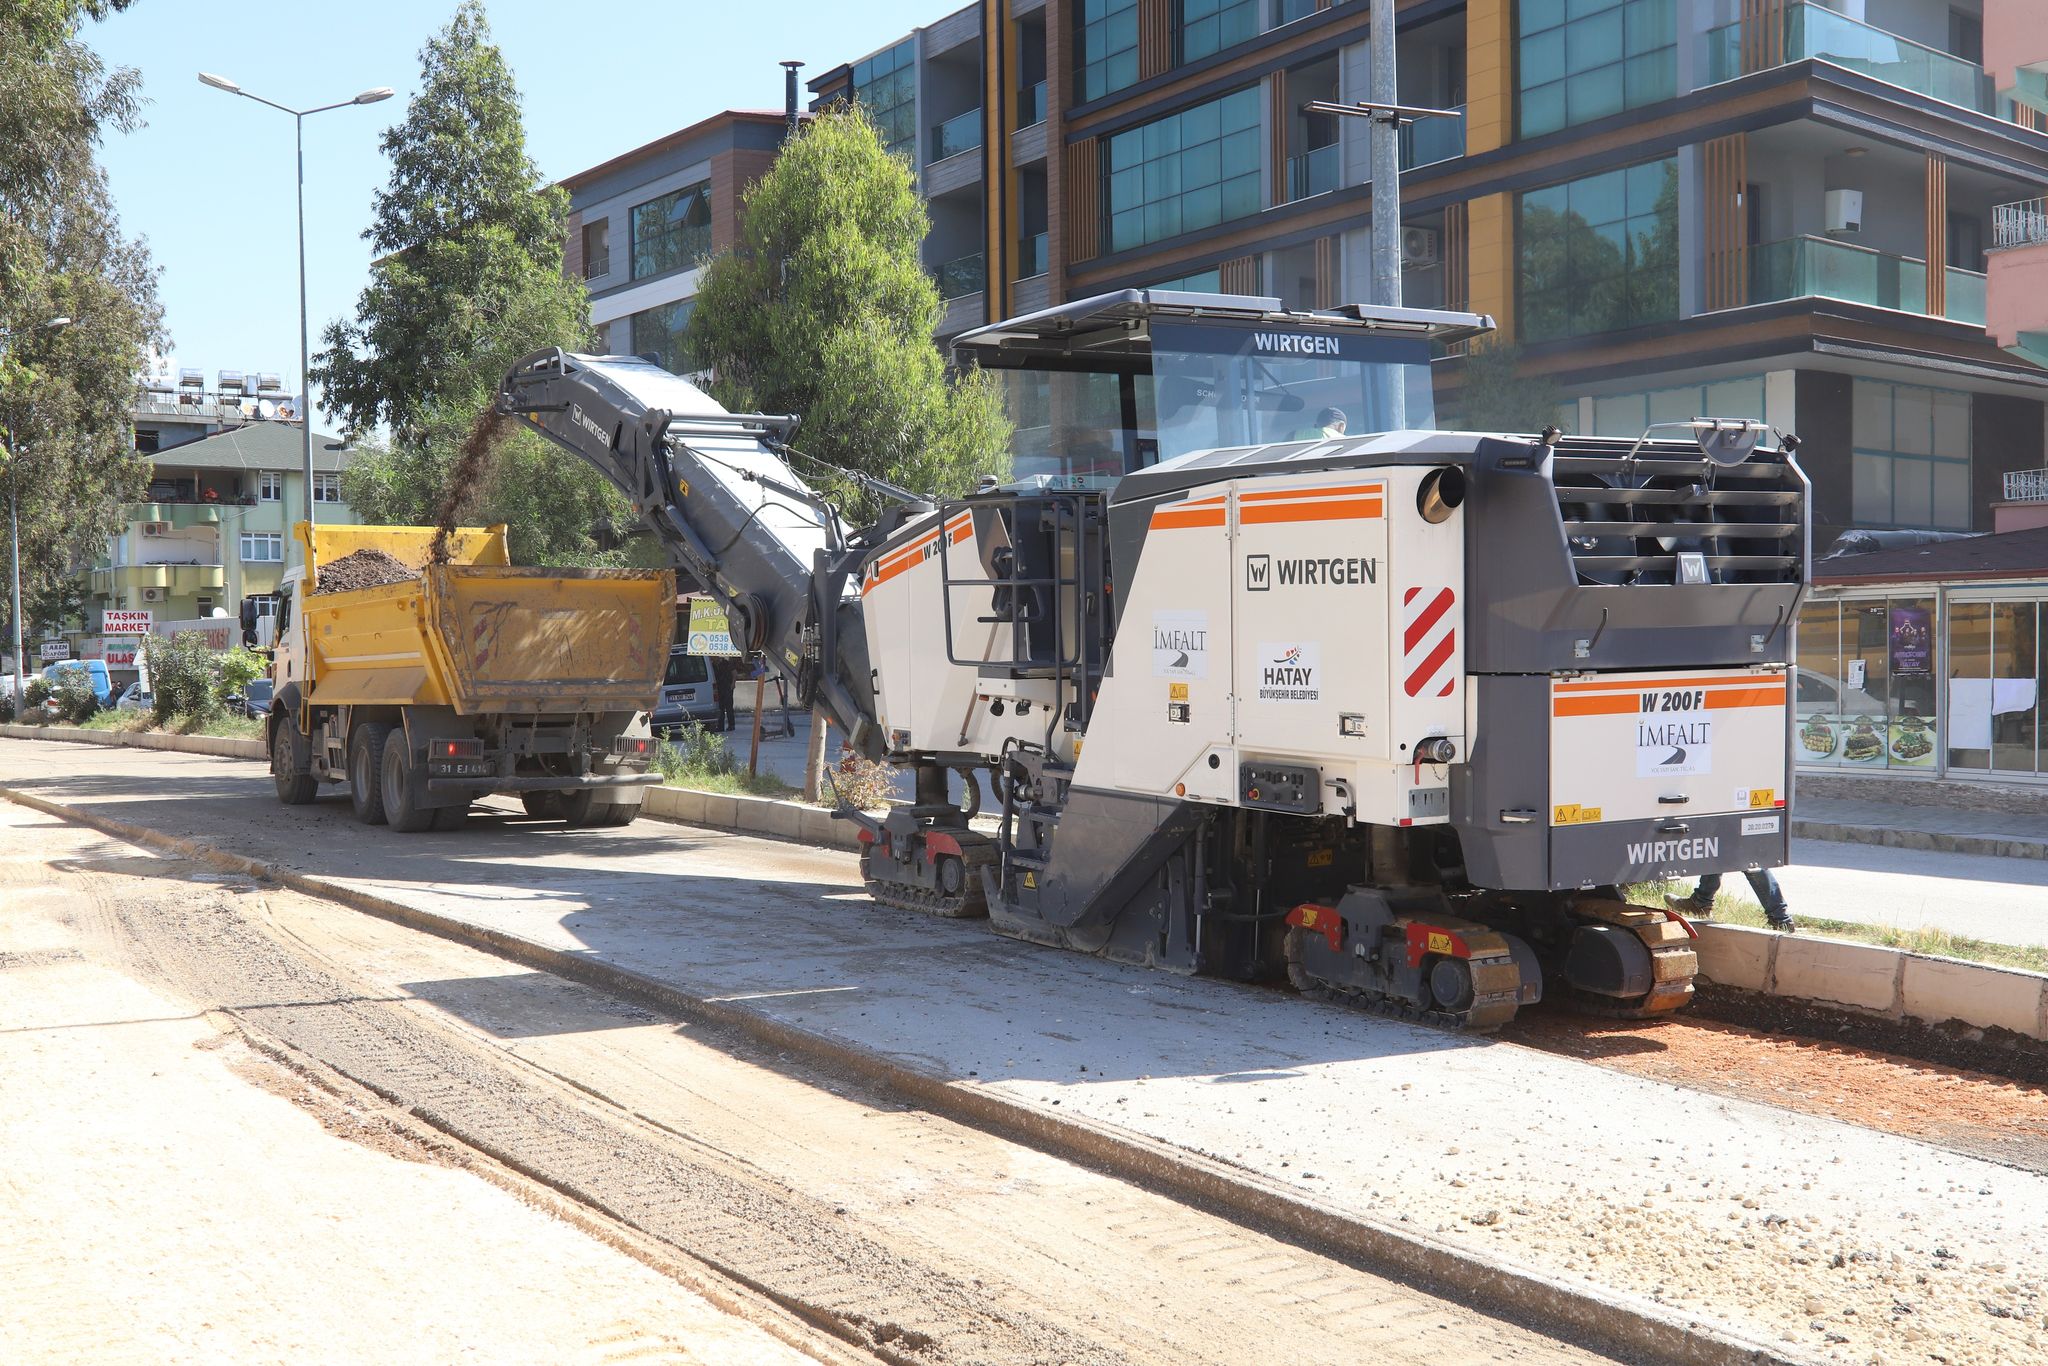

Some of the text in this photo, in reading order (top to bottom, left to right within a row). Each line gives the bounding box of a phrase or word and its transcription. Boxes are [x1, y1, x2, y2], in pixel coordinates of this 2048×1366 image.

[1254, 332, 1340, 355] WIRTGEN
[582, 414, 611, 448] WIRTGEN
[923, 532, 953, 561] W 20F
[1250, 557, 1377, 585] W WIRTGEN
[1684, 561, 1701, 577] W
[106, 612, 149, 622] TAŞKIN
[705, 618, 728, 631] TA
[105, 623, 151, 632] MARKET
[709, 634, 729, 643] 0536
[709, 643, 729, 651] 0538
[1154, 625, 1207, 651] İMFALT
[1264, 667, 1312, 686] HATAY
[1259, 686, 1319, 702] BÜYÜKŞEHİR BELEDİYESİ
[1642, 693, 1659, 713] W
[1638, 720, 1711, 747] İMFALT
[441, 764, 451, 773] 31
[1627, 836, 1719, 865] WIRTGEN
